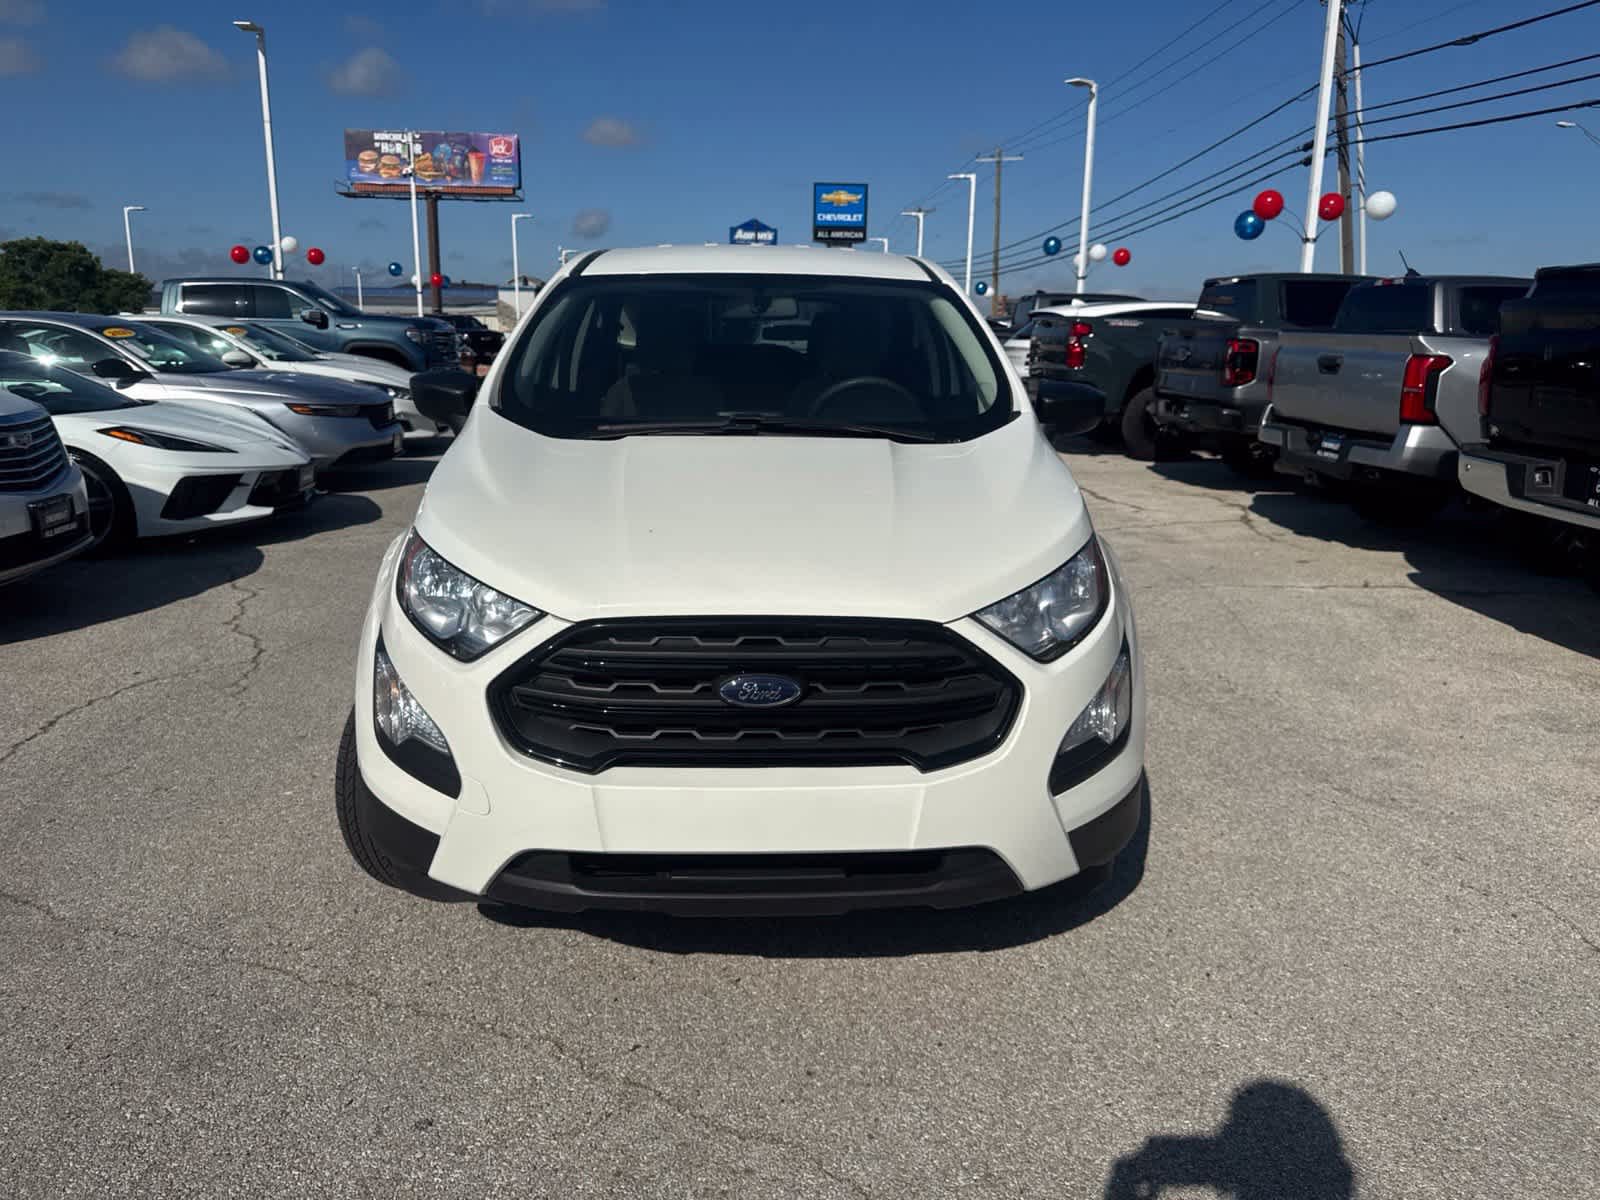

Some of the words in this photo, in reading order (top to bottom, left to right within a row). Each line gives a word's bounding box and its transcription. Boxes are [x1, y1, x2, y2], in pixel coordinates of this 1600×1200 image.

[817, 213, 863, 222] CHEVROLET
[816, 231, 829, 239] ALL
[830, 231, 864, 239] AMERICAN
[738, 682, 781, 700] Ford
